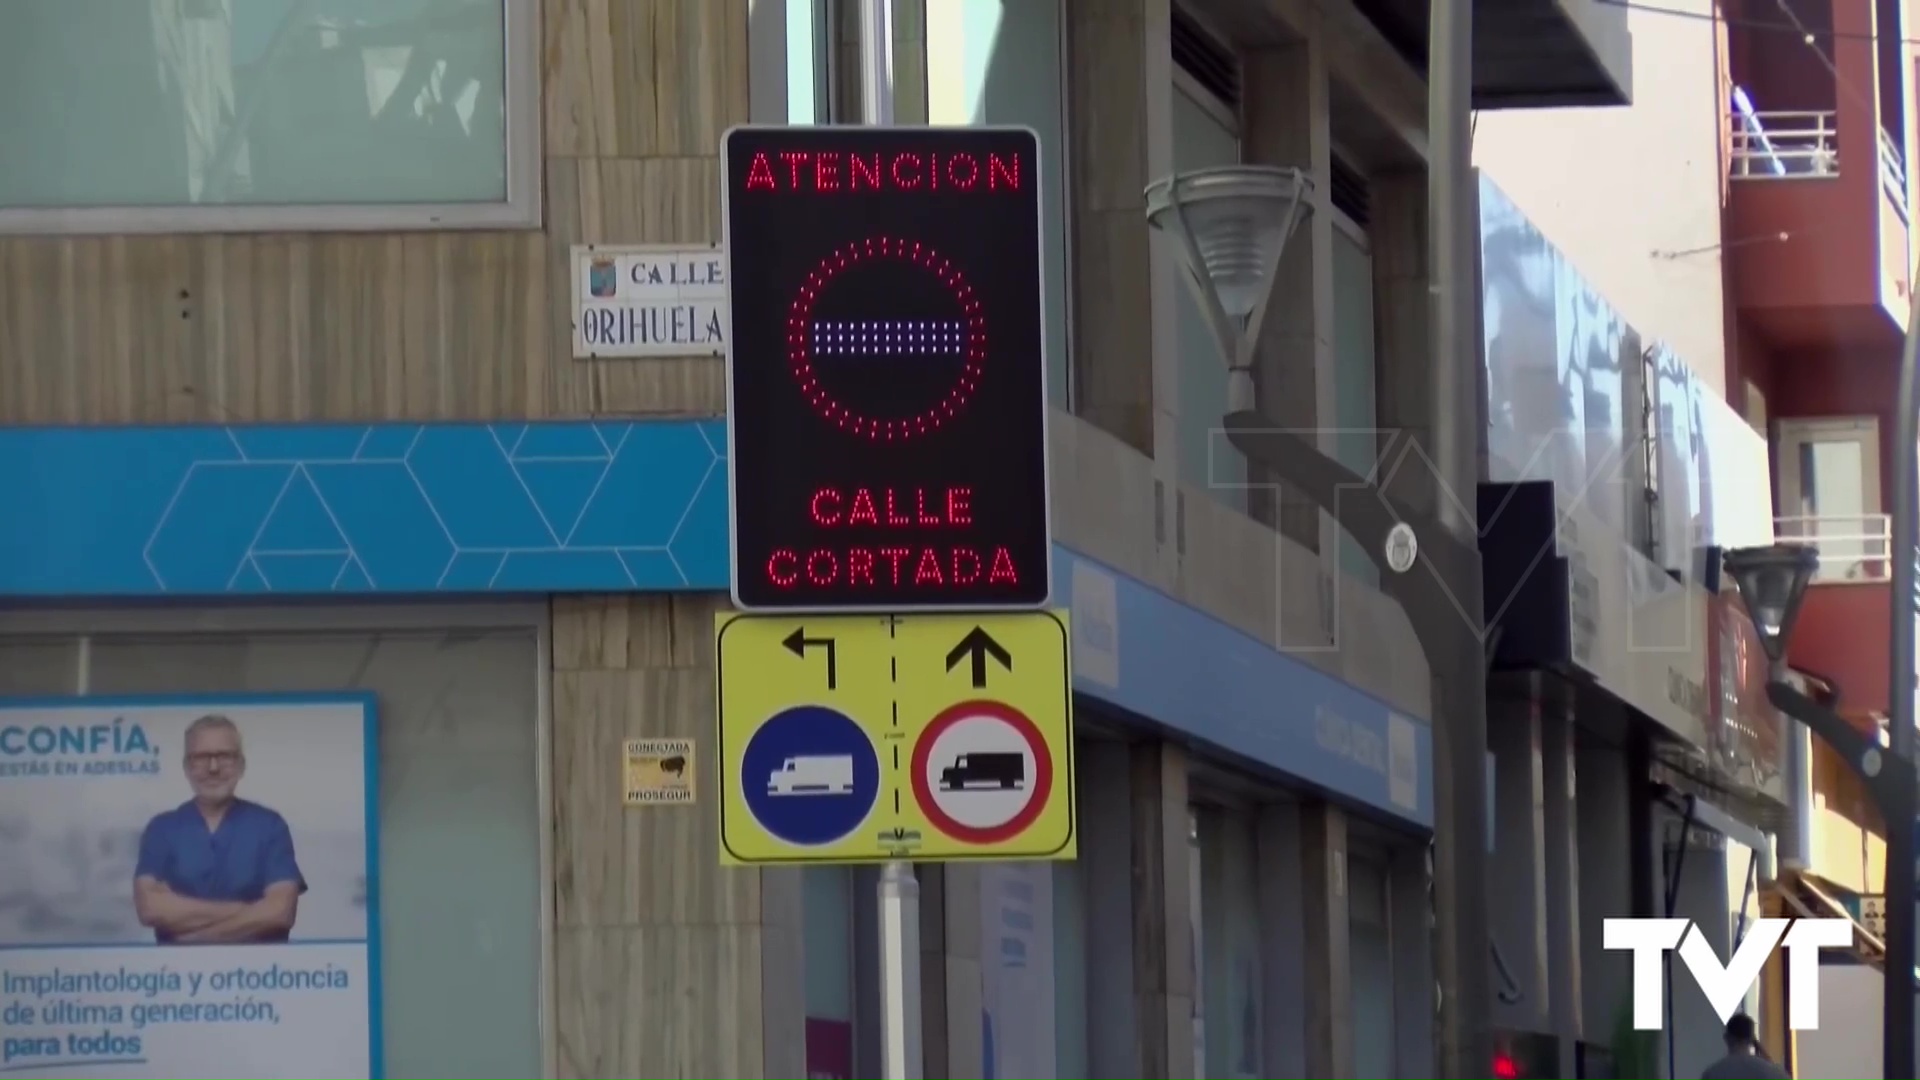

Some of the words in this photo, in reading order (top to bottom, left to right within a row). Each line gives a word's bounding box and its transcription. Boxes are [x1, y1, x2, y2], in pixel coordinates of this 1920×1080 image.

[747, 152, 1019, 189] ATENCION
[631, 261, 724, 285] CALLE
[583, 306, 723, 345] ORIHUELA
[812, 488, 971, 525] CALLE
[768, 548, 1017, 585] CORTADA
[0, 716, 160, 757] CONFÍA,
[55, 761, 78, 775] EN
[83, 759, 160, 775] ADESLAS
[628, 791, 691, 801] PROSEGUR
[3, 965, 181, 998] Implantología
[189, 970, 203, 997] y
[210, 963, 349, 990] ortodoncia
[3, 1001, 35, 1026] de
[42, 999, 123, 1025] última
[131, 997, 280, 1029] generación,
[3, 1037, 61, 1062] para
[67, 1030, 142, 1056] todos
